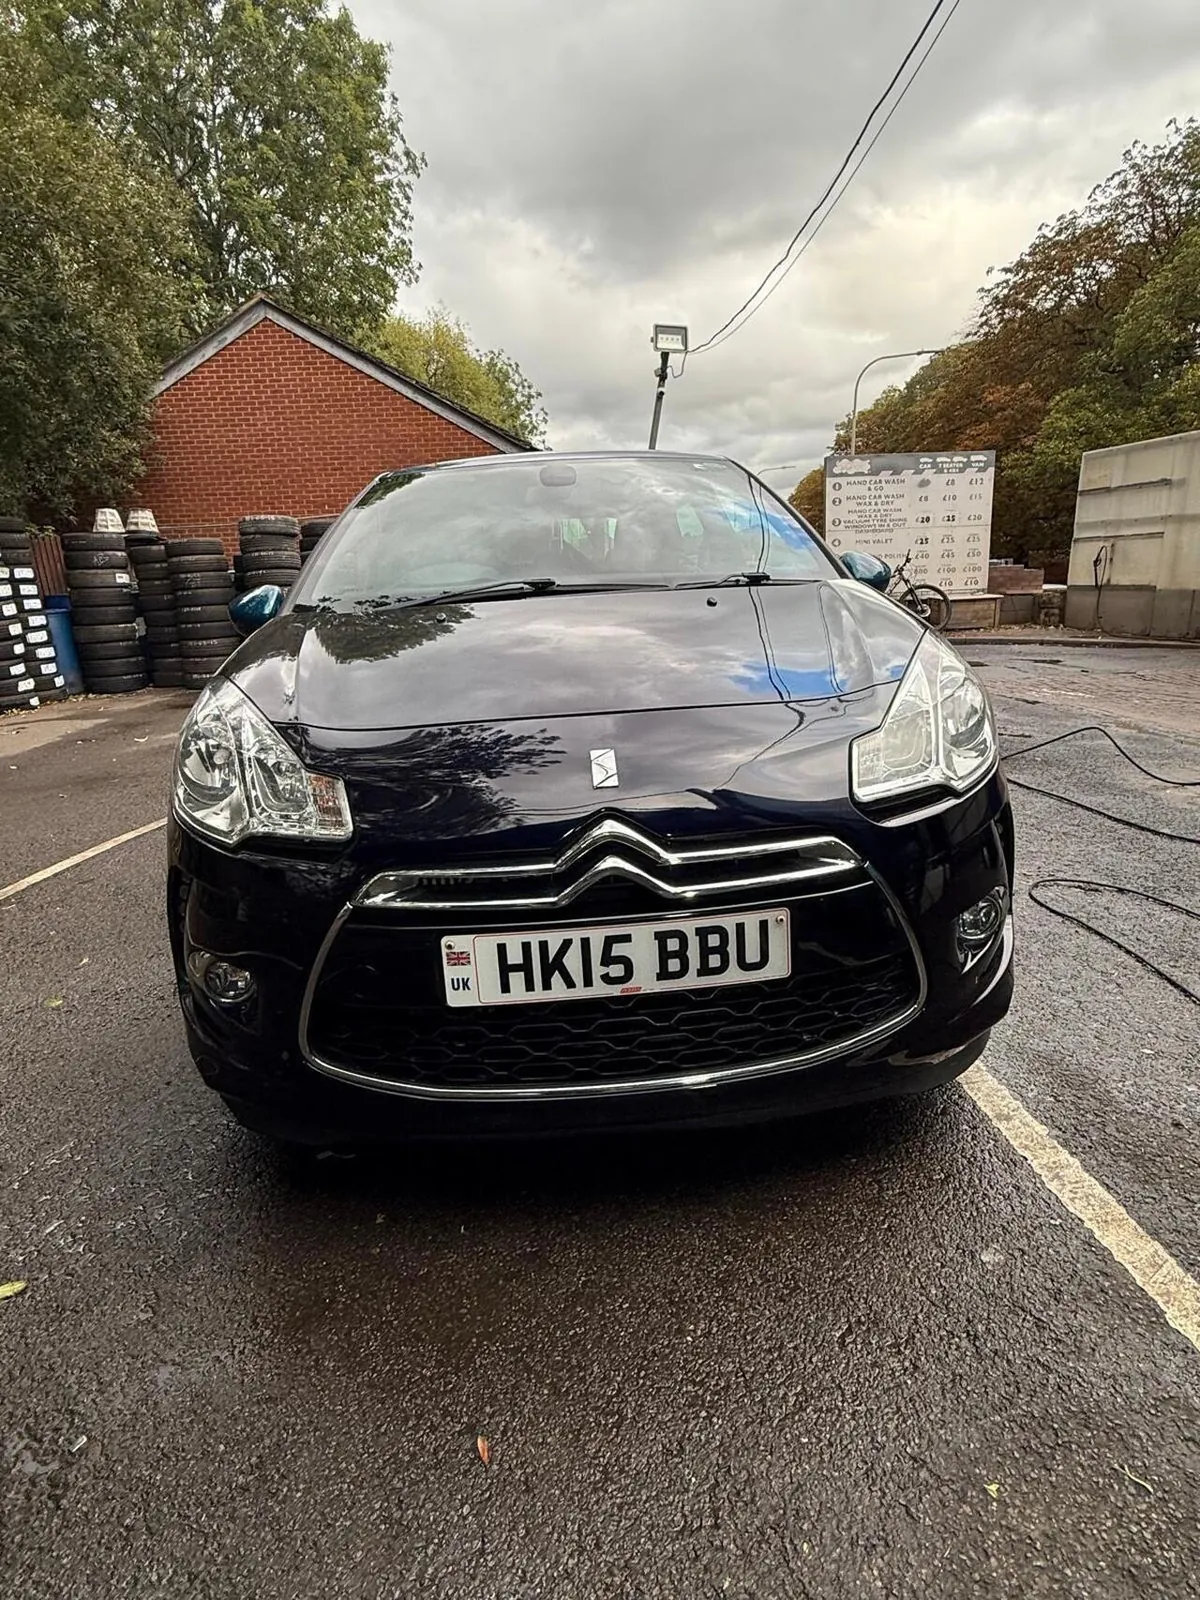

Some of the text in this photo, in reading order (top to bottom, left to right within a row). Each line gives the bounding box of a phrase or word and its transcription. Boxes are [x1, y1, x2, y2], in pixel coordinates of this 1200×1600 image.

[496, 918, 770, 994] HK15 BBU
[450, 976, 471, 993] UK
